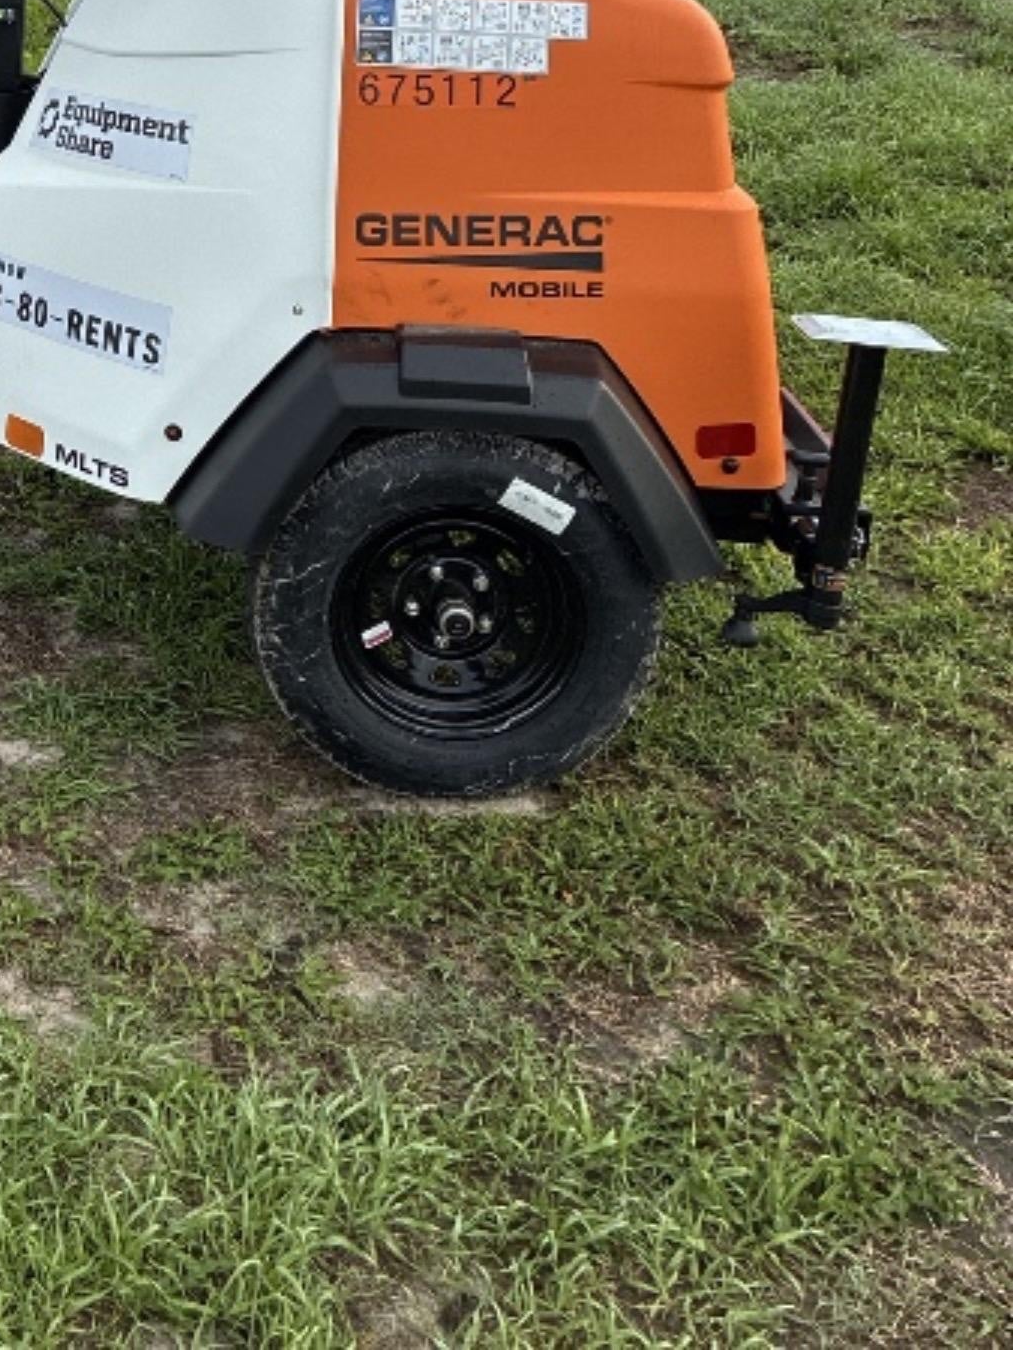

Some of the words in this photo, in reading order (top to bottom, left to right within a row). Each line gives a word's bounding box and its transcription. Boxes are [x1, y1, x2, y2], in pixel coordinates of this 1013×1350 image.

[358, 74, 517, 107] 675112
[63, 96, 189, 144] Equipment
[55, 125, 114, 160] Share
[355, 214, 604, 247] GENERAC
[490, 282, 604, 298] MOBILE
[54, 443, 129, 488] MLTS
